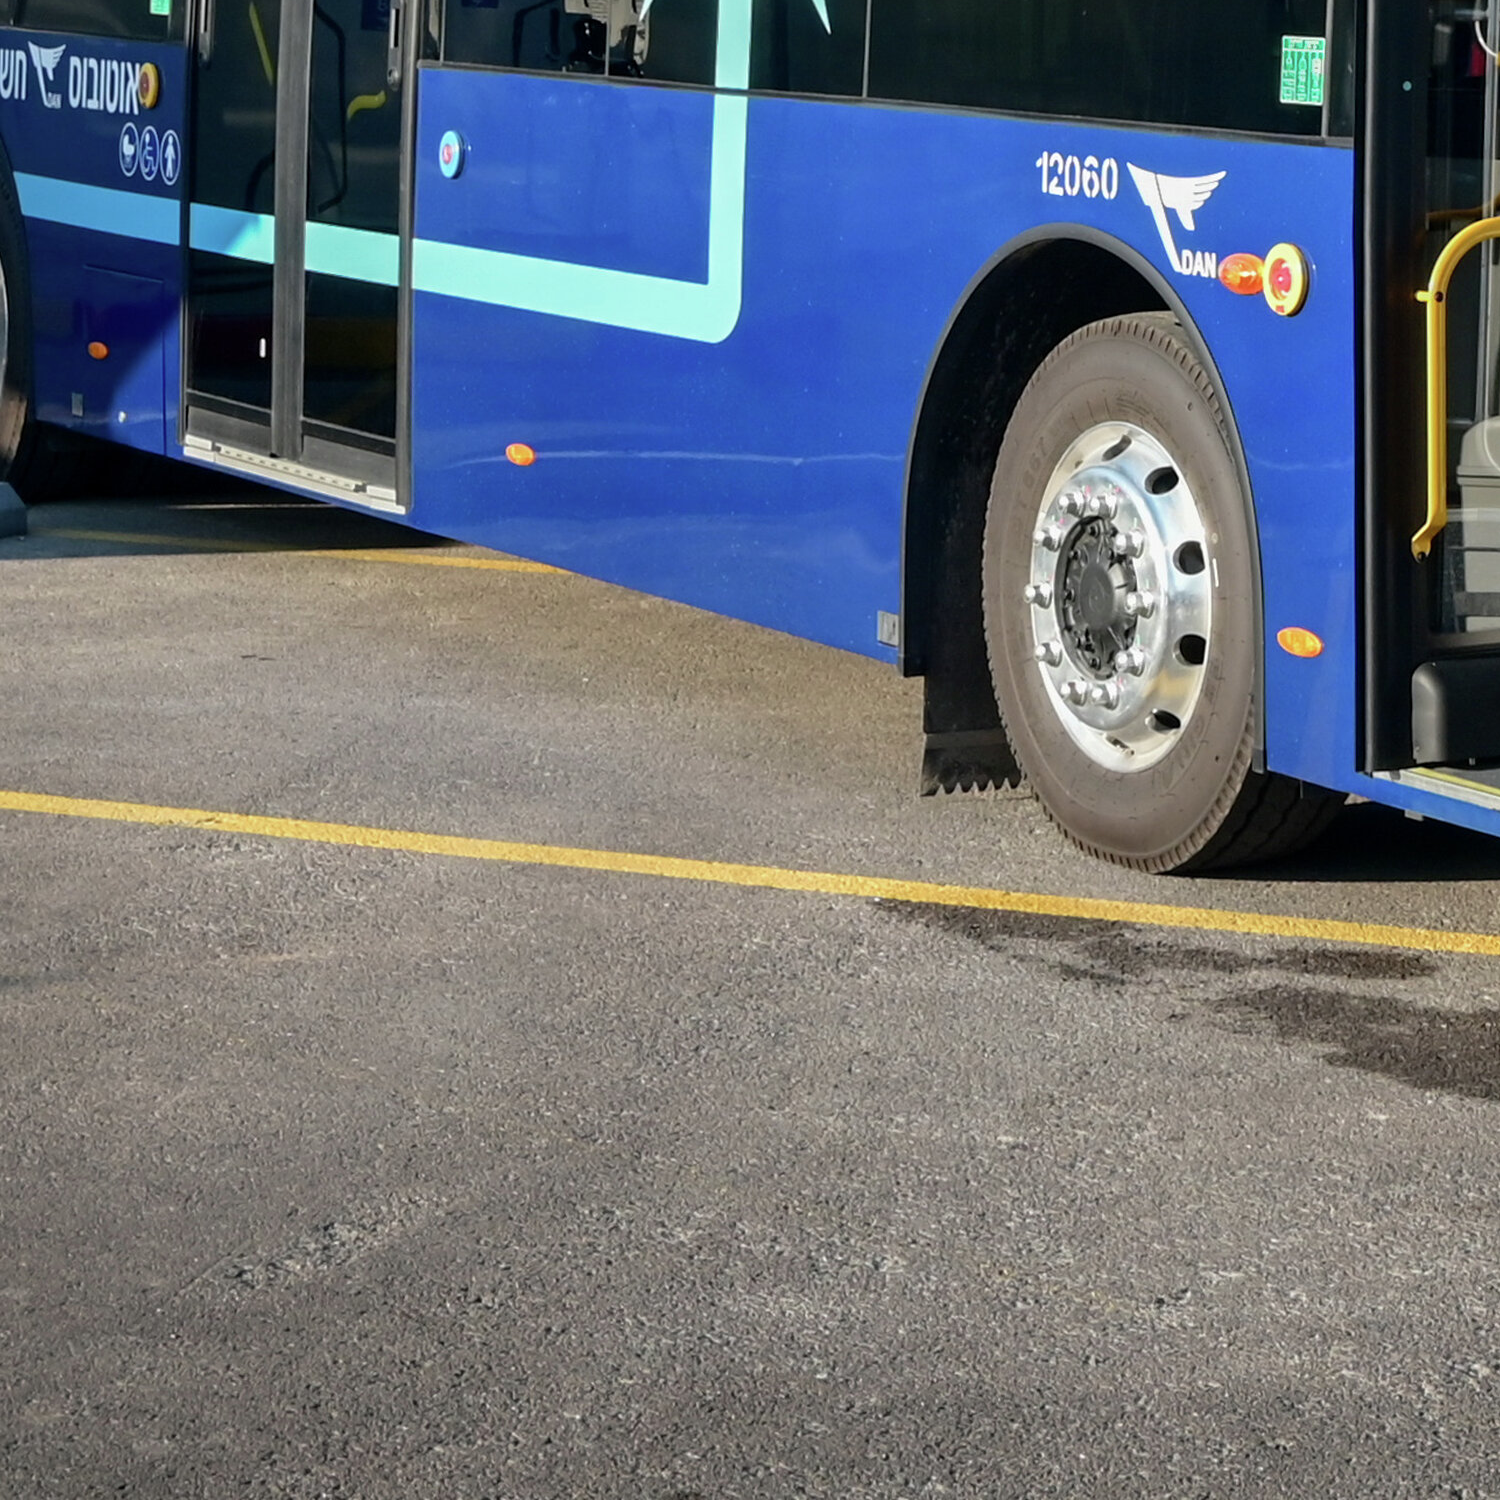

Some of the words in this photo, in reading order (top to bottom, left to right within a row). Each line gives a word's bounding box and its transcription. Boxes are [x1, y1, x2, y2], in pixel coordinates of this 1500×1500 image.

[68, 56, 140, 116] אוטובוס
[1035, 151, 1118, 200] 12060
[1181, 250, 1217, 279] DAN
